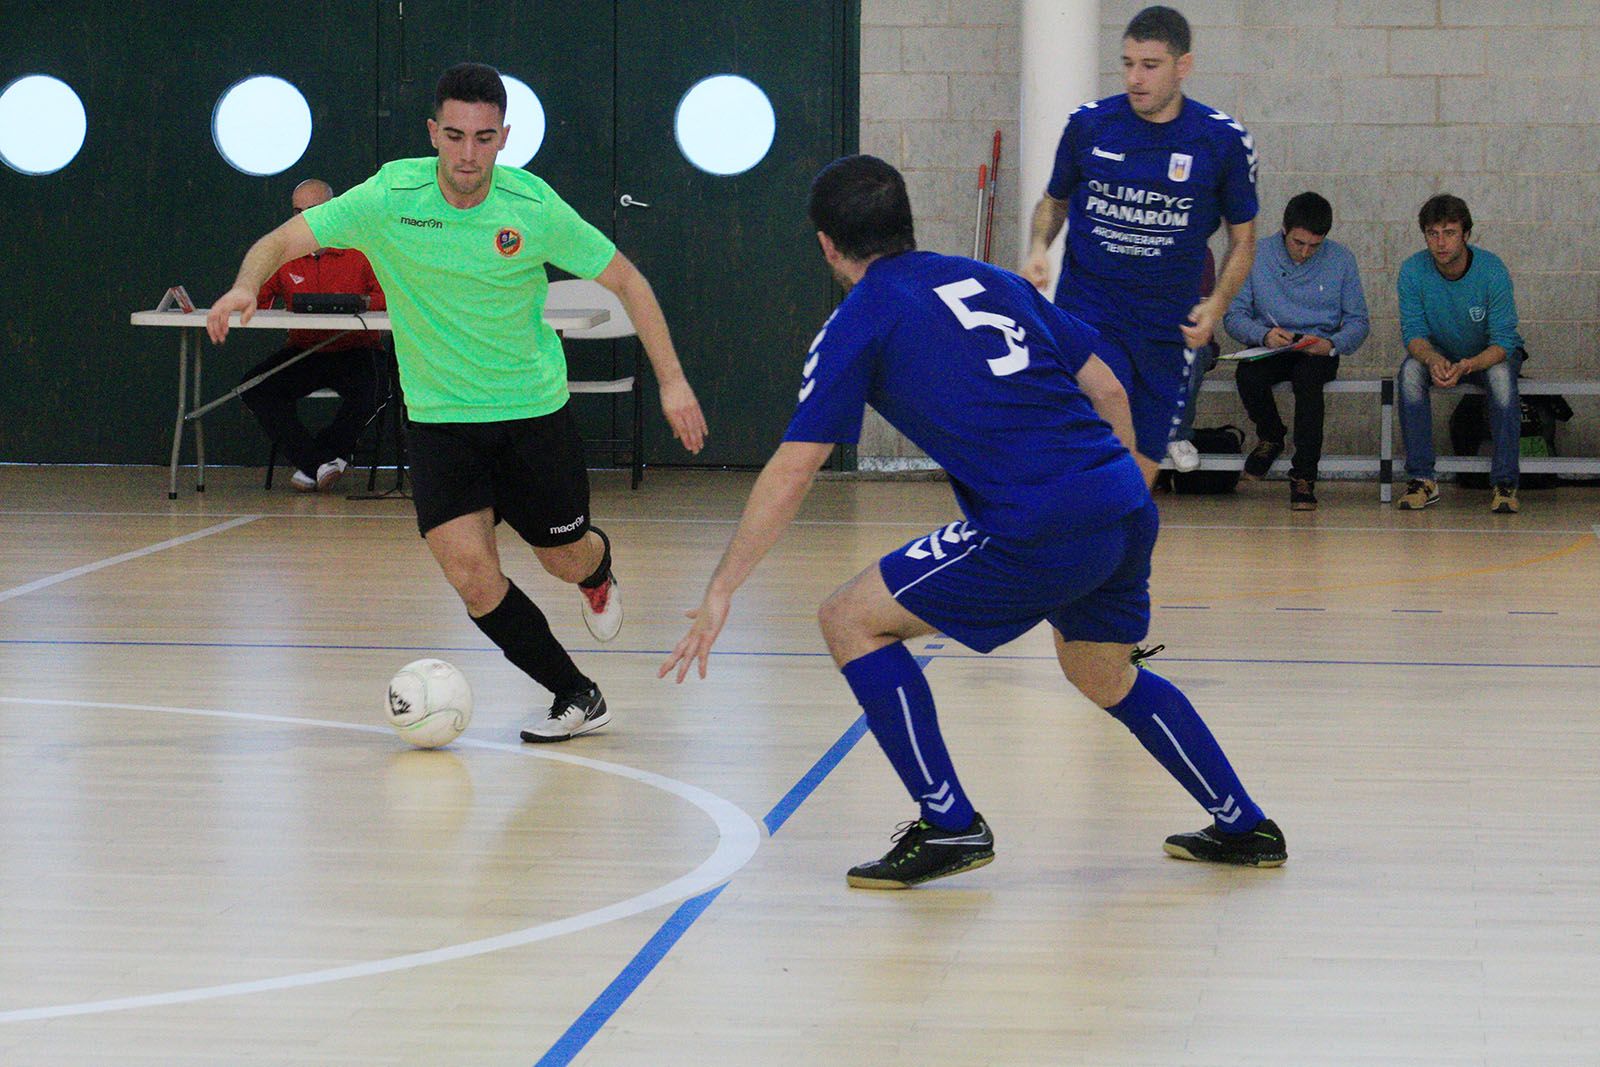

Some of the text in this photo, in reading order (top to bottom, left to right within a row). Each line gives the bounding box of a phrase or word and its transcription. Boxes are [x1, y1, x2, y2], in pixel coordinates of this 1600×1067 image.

[1088, 179, 1195, 210] OLIMPYC
[400, 216, 443, 229] macron
[932, 277, 1030, 377] 5
